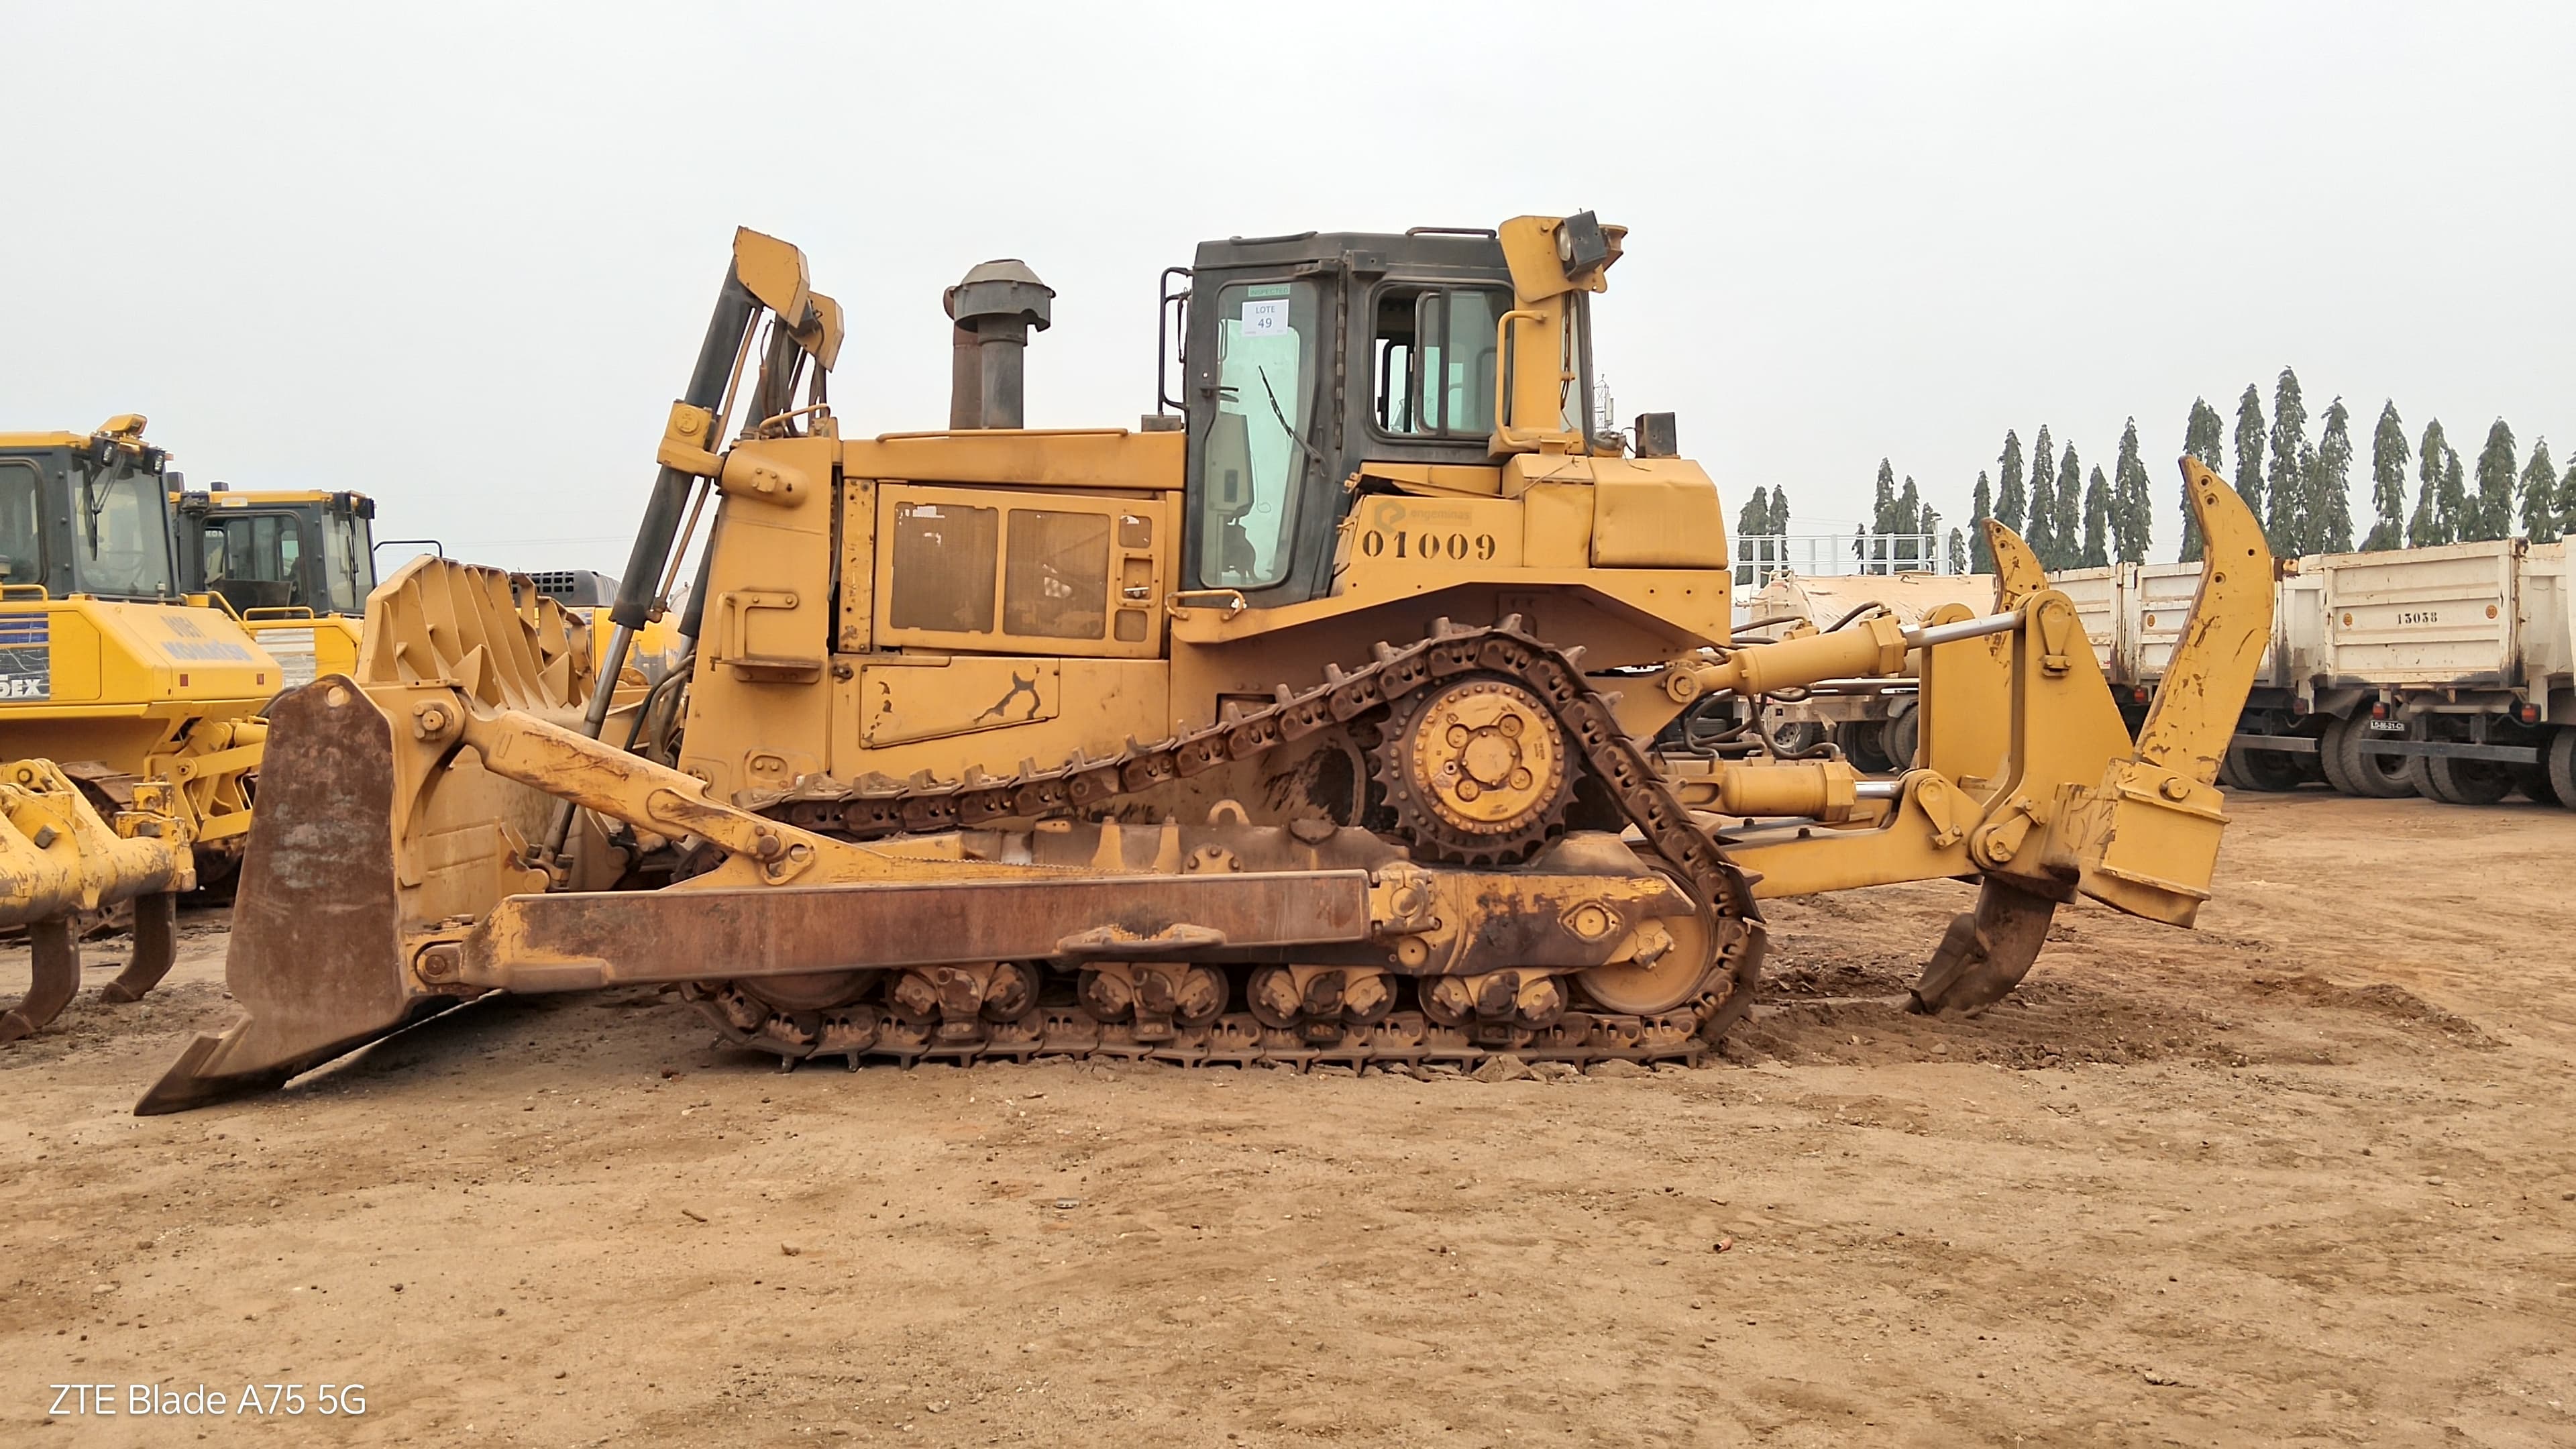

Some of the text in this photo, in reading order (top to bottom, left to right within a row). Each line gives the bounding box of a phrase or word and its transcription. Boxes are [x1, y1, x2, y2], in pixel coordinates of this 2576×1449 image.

[1256, 305, 1275, 314] LOTE
[1258, 317, 1272, 328] 49
[1362, 530, 1495, 560] 01009
[2398, 611, 2438, 625] 13038
